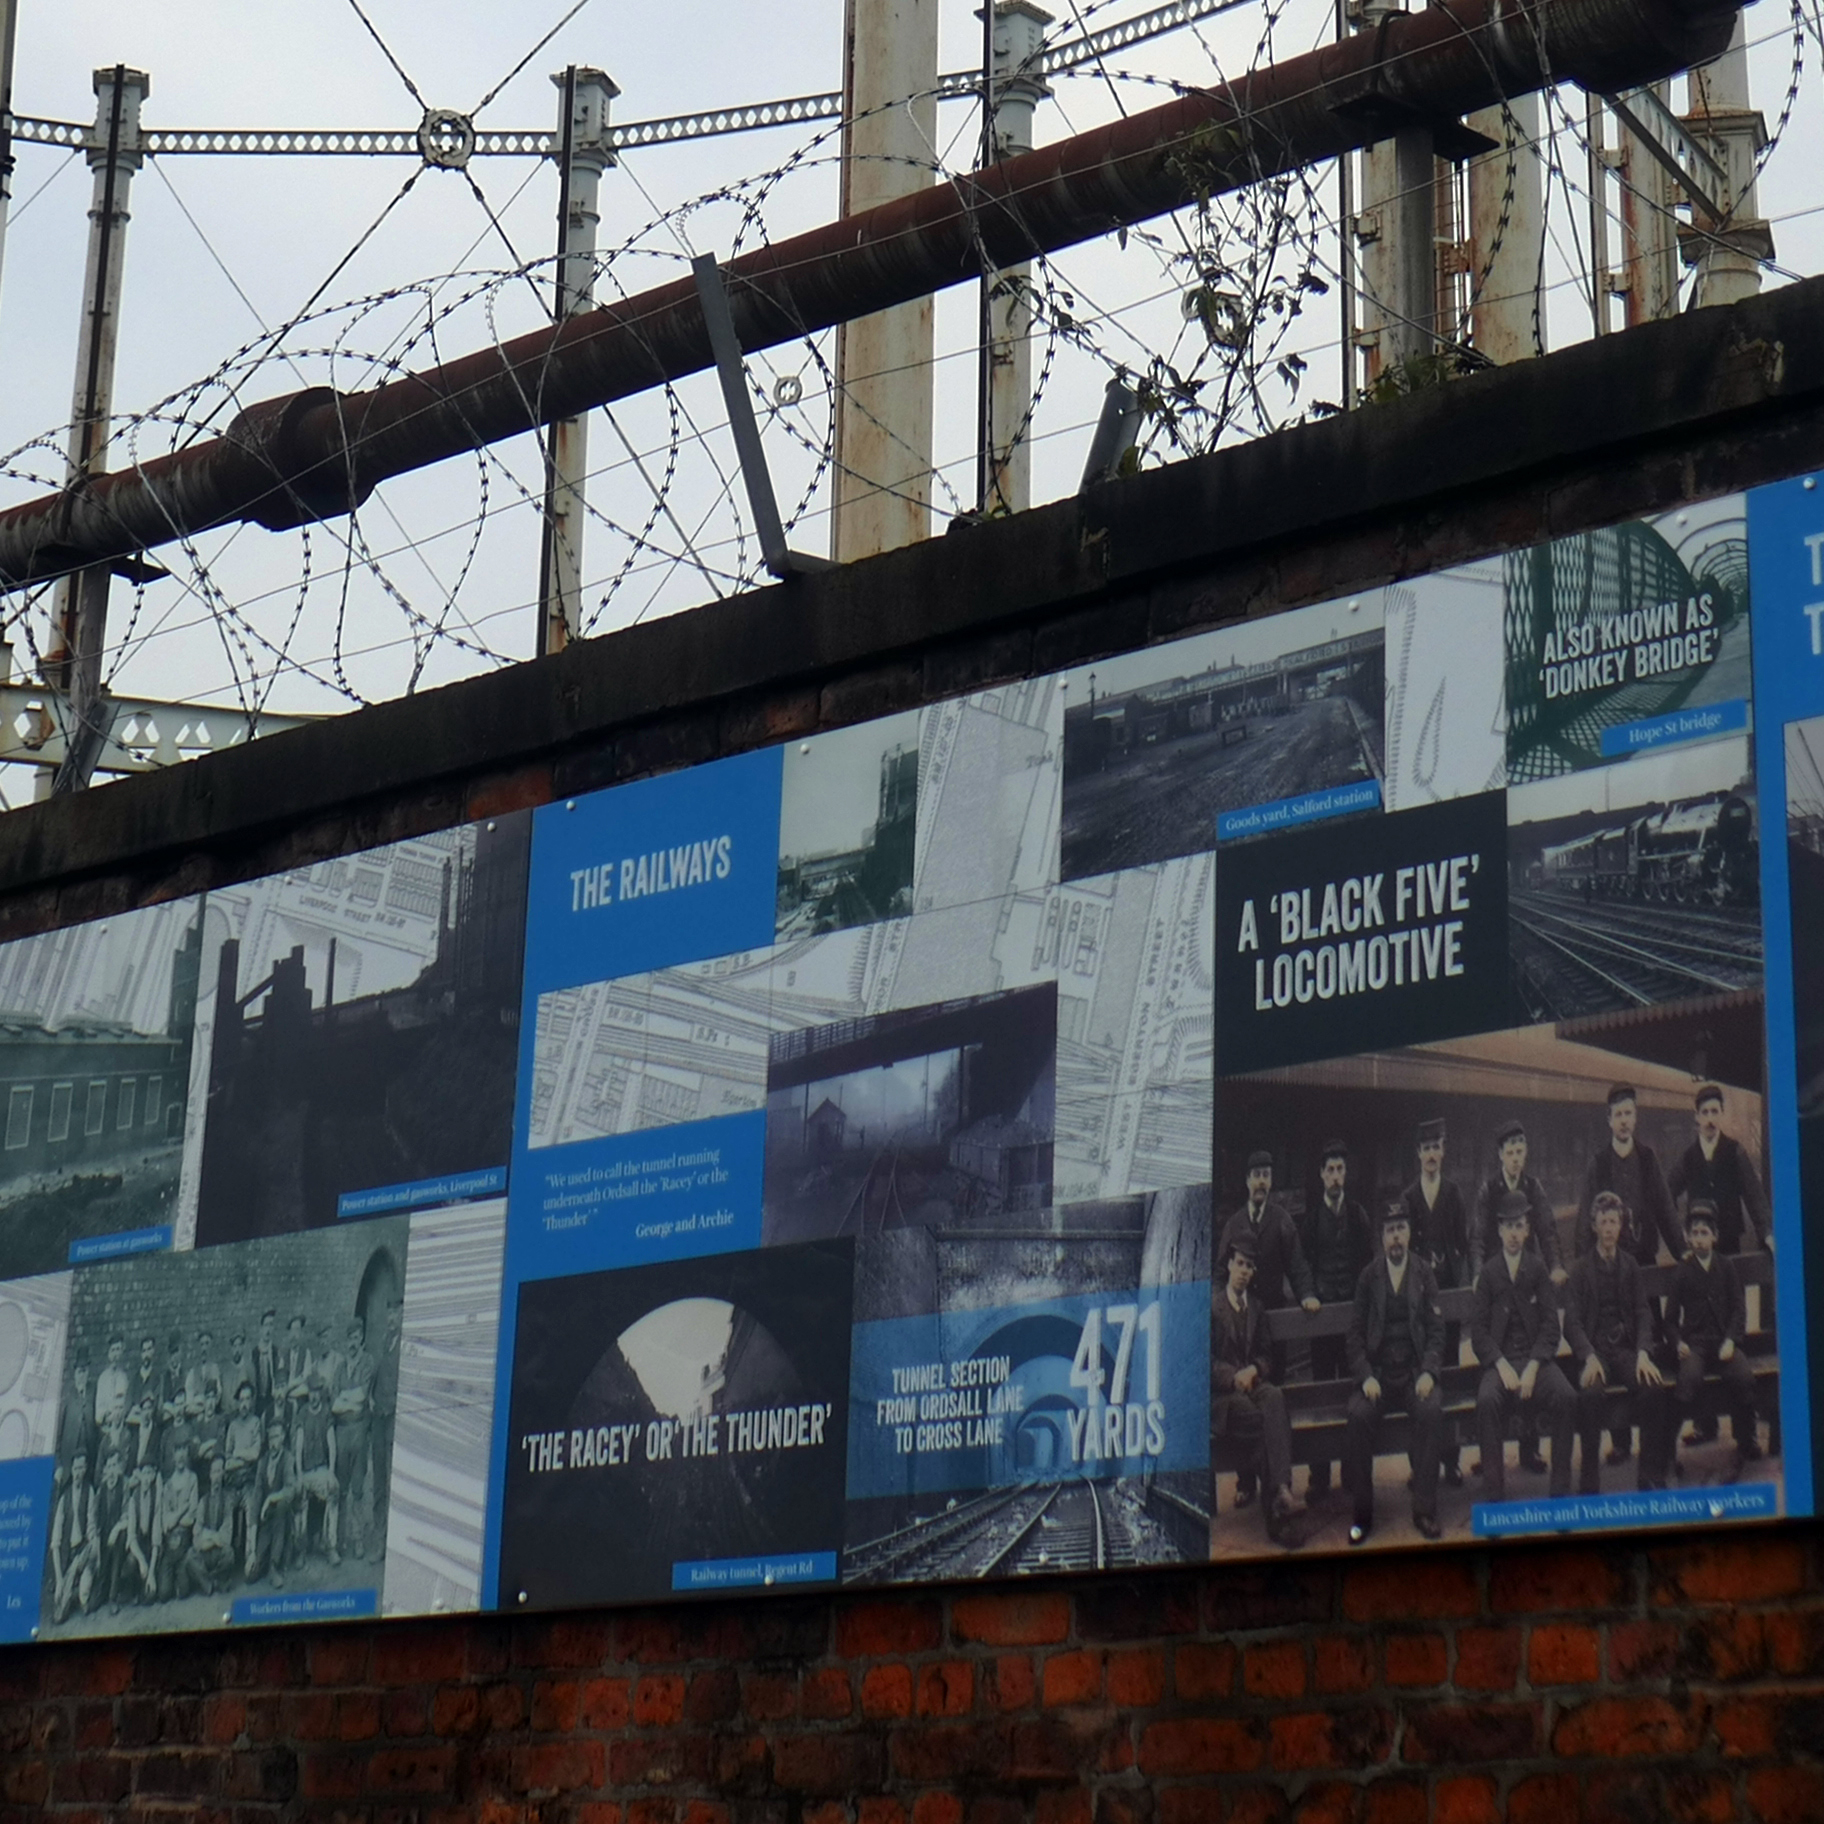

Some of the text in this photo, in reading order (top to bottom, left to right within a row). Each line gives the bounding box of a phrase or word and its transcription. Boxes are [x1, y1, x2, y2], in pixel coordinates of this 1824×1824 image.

[1544, 593, 1714, 664] ALSO KNOWN AS
[1539, 628, 1719, 699] 'DONKEY BRIDGE'
[1629, 715, 1721, 743] Hope St bridge
[1226, 791, 1373, 829] Goods yard, Salford station
[570, 835, 731, 912] THE RAILWAYS
[1238, 854, 1480, 952] A 'BLACK FIVE'
[1256, 921, 1465, 1011] LOCOMOTIVE
[546, 1149, 719, 1189] "We used to call the tunnel running
[544, 1170, 728, 1211] underneath Ordsall the 'Racey' or the
[636, 1211, 734, 1237] George and Archie
[1069, 1300, 1161, 1407] 471
[892, 1355, 1010, 1394] TUNNEL SECTION
[877, 1385, 1024, 1426] FROM ORDSALL LANE
[522, 1403, 832, 1473] 'THE RACEY' OR 'THE THUNDER'
[895, 1418, 1003, 1454] TO CROSS LANE
[1066, 1399, 1166, 1461] YARDS
[1482, 1505, 1551, 1525] Lancashire
[1554, 1503, 1579, 1520] and
[1583, 1499, 1646, 1518] Yorkshire
[1650, 1496, 1704, 1514] Railway
[691, 1568, 727, 1582] Railway
[729, 1564, 762, 1579] tunnel,
[799, 1560, 813, 1573] Rd
